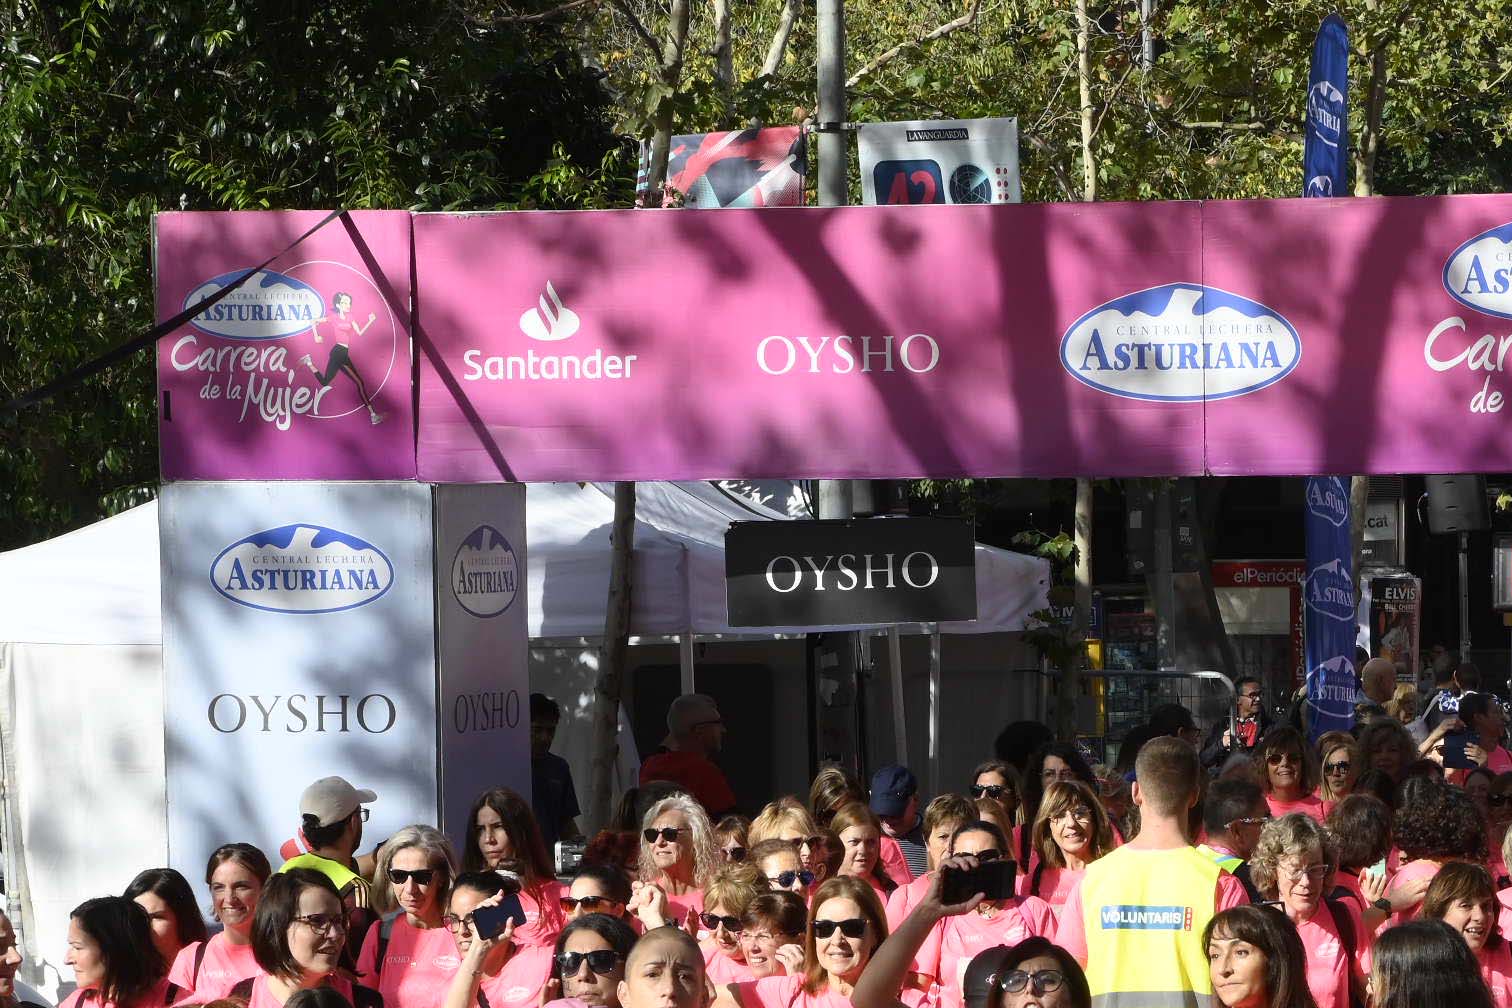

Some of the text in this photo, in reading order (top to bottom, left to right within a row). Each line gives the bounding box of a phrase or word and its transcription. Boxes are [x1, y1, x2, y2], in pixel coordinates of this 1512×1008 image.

[1116, 323, 1274, 336] CENTRAL LECHERA
[169, 334, 289, 373] Carrera
[463, 349, 638, 381] Santander
[756, 333, 941, 376] OYSHO
[1079, 328, 1283, 371] ASTURIANA
[200, 368, 333, 431] de la Mujer
[1469, 375, 1505, 414] de
[224, 557, 381, 591] ASTURIANA
[252, 554, 375, 565] CENTRAL LECHERA
[457, 559, 515, 596] ASTURIANA
[765, 551, 940, 594] OYSHO
[1385, 587, 1416, 601] ELVIS
[207, 693, 397, 735] OYSHO
[453, 689, 521, 734] OYSHO
[1101, 910, 1182, 924] VOLUNTARIS
